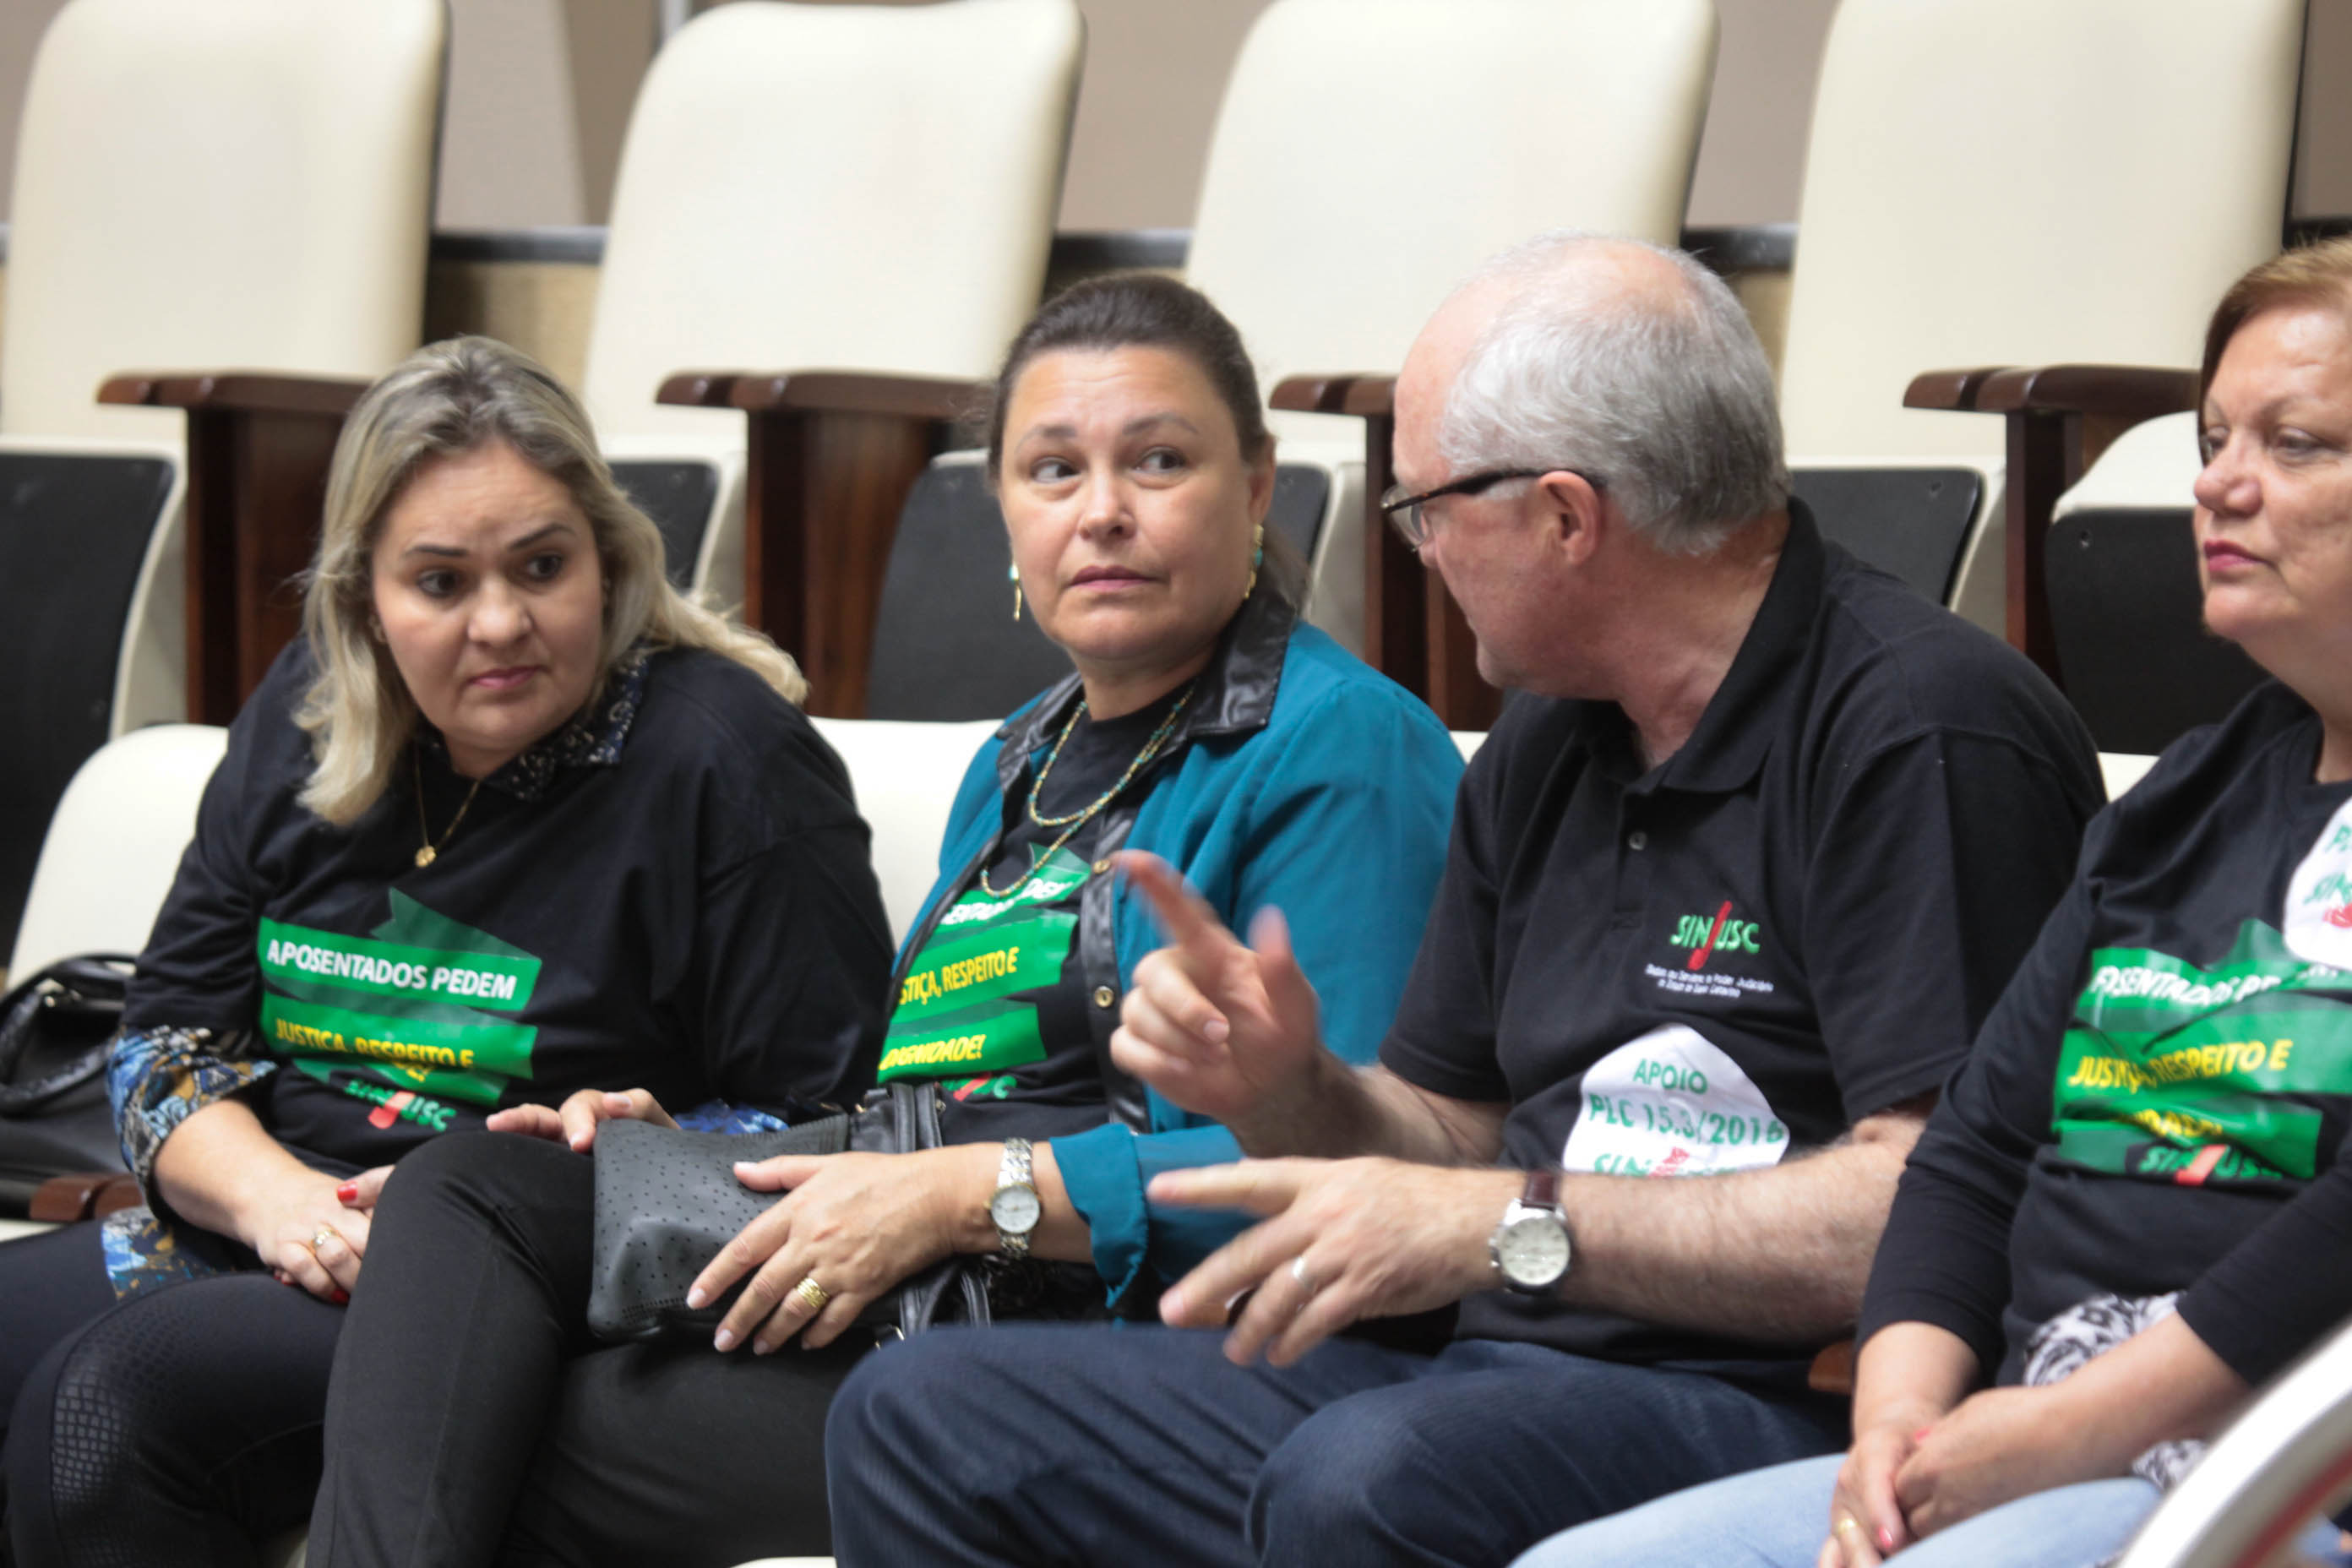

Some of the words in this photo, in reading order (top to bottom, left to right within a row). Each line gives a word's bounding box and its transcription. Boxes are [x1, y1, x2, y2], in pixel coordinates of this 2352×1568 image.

[266, 939, 427, 990] APOSENTADOS
[431, 966, 517, 1000] PEDEM
[898, 971, 942, 1004] STIÇA,
[942, 950, 1006, 992] RESPEITO
[1006, 946, 1021, 973] E
[459, 1048, 474, 1067] E
[2268, 1038, 2293, 1070] E
[1633, 1058, 1707, 1095] APOIO
[1589, 1093, 1634, 1128] PLC
